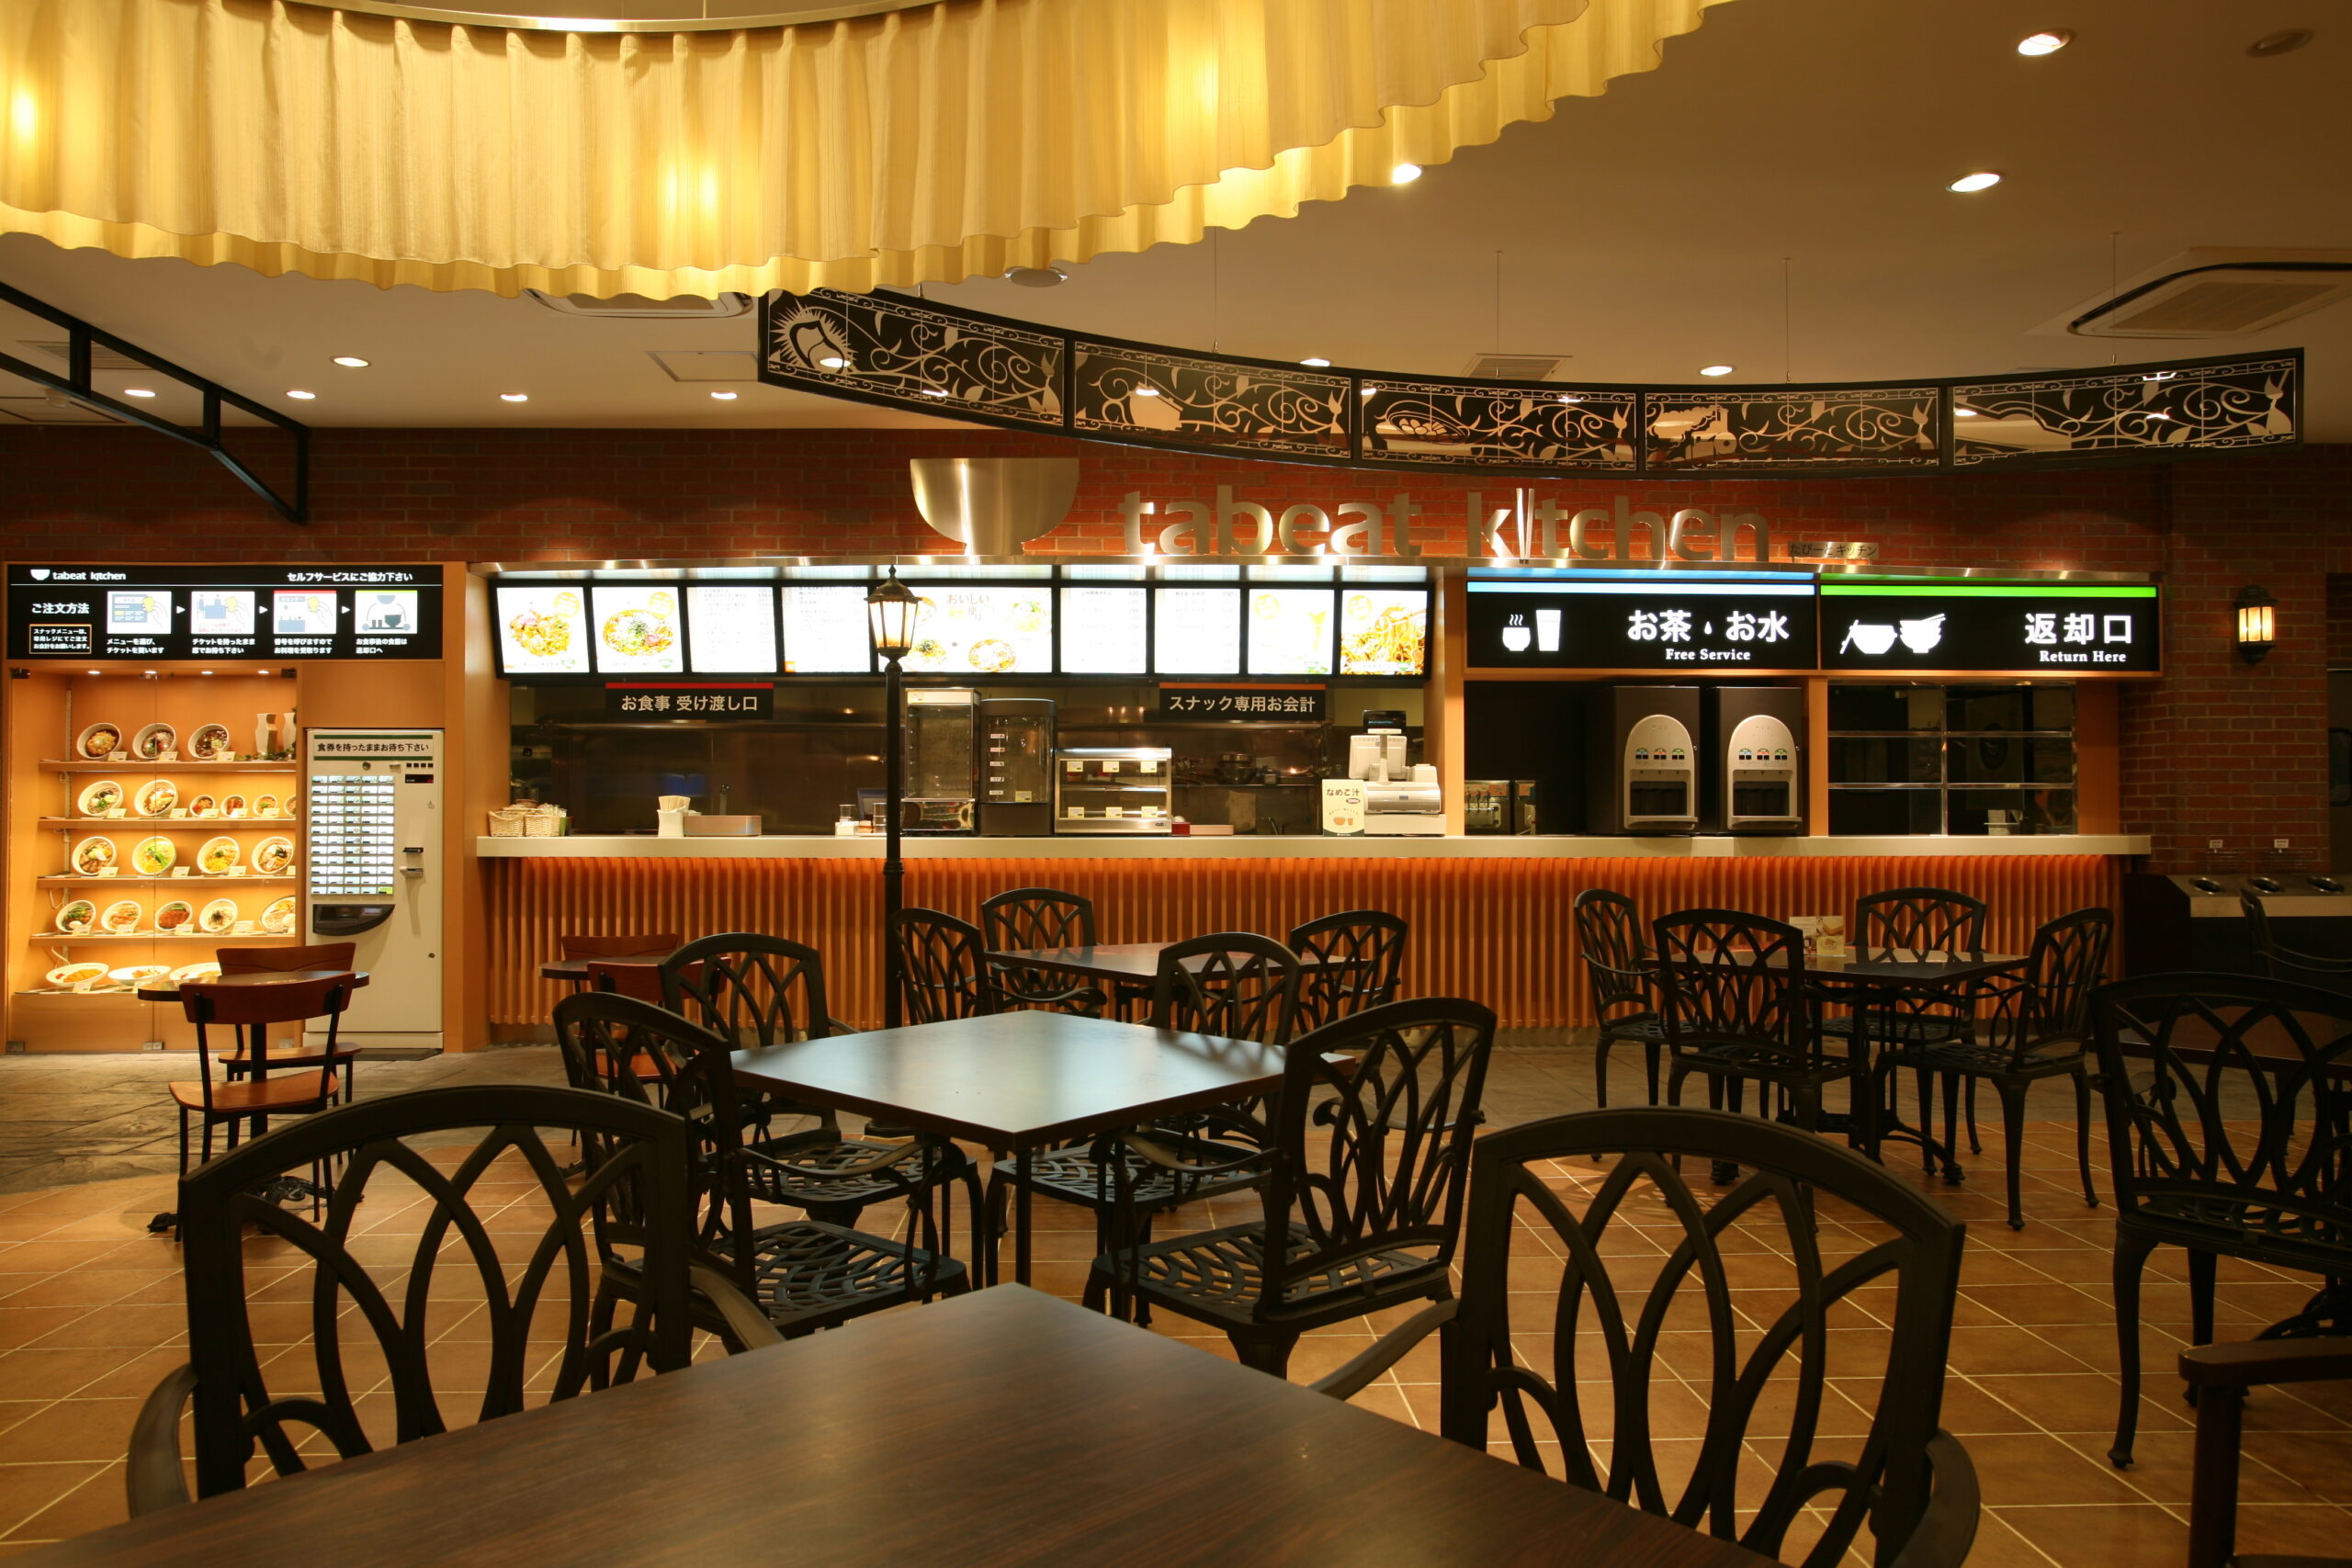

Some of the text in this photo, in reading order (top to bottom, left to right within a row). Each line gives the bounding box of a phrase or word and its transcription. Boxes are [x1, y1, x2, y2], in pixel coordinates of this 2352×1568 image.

[1117, 485, 1770, 563] tabeat kitchen
[52, 571, 126, 581] tabeat kitchen
[287, 572, 413, 582] セルフサービスにご協力下さい
[31, 603, 90, 615] ご注文方法
[2024, 613, 2132, 645] 返却口
[1666, 649, 1751, 660] Free Service
[2040, 650, 2127, 662] Return Here
[621, 695, 757, 712] お食事 受け渡し口
[1170, 696, 1316, 713] スナック専用お会計
[317, 743, 429, 752] 食券を持ったままお待ち下さい
[1326, 788, 1360, 796] なめこ汁
